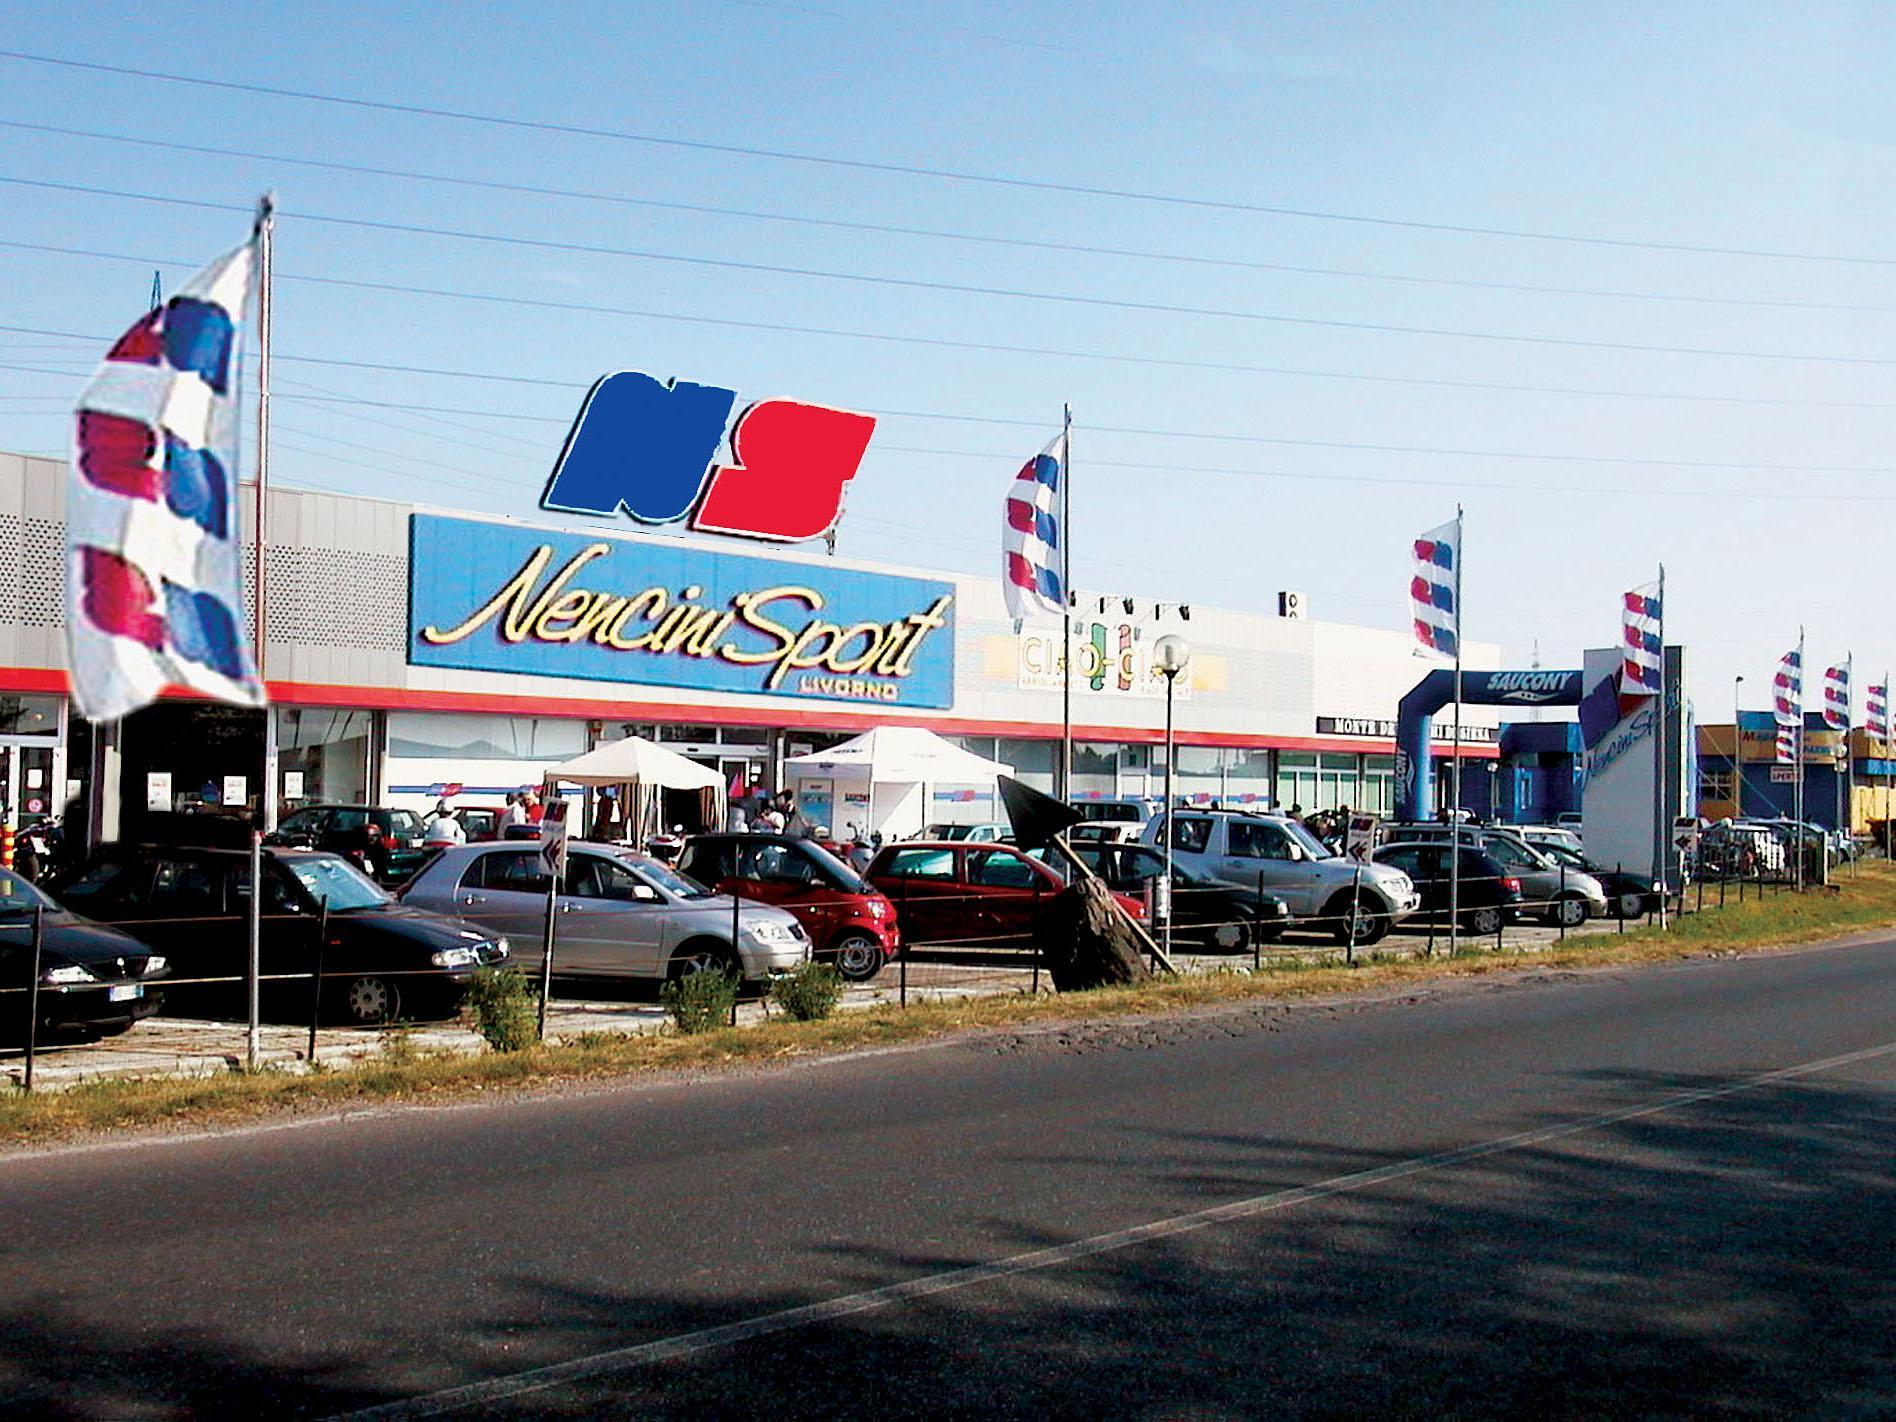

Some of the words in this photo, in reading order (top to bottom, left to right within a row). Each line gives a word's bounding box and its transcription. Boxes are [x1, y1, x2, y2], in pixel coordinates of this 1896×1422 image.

[719, 586, 950, 692] Sport
[799, 676, 899, 700] LIVORNO
[1487, 672, 1574, 690] SAUCONY
